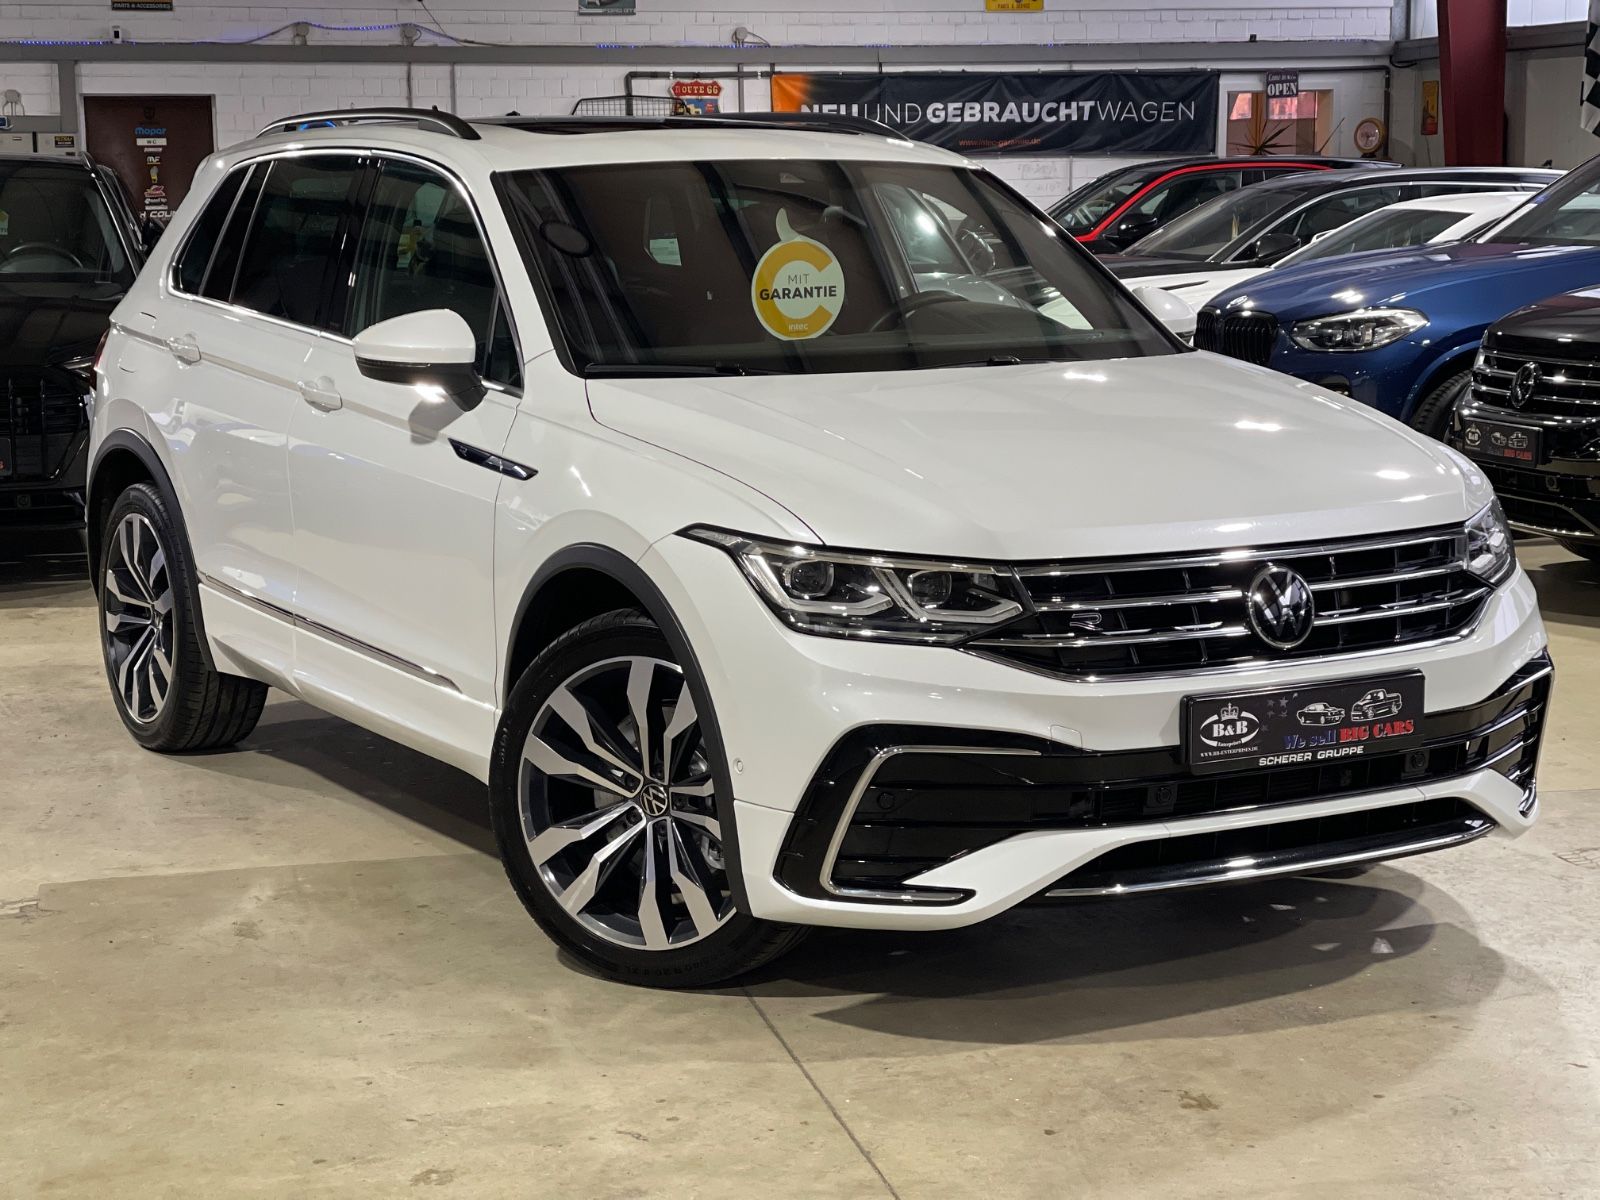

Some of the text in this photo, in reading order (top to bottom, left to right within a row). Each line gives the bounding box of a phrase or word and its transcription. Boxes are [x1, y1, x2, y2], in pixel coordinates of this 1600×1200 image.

[675, 85, 719, 95] ROUTE 66
[1267, 82, 1298, 97] OPEN
[788, 273, 811, 284] MIT
[759, 285, 837, 301] GARANTIE
[1212, 720, 1248, 738] B&B
[1284, 719, 1415, 750] We sell BIG CARS
[1258, 745, 1365, 767] SCHERER GRUPPE
